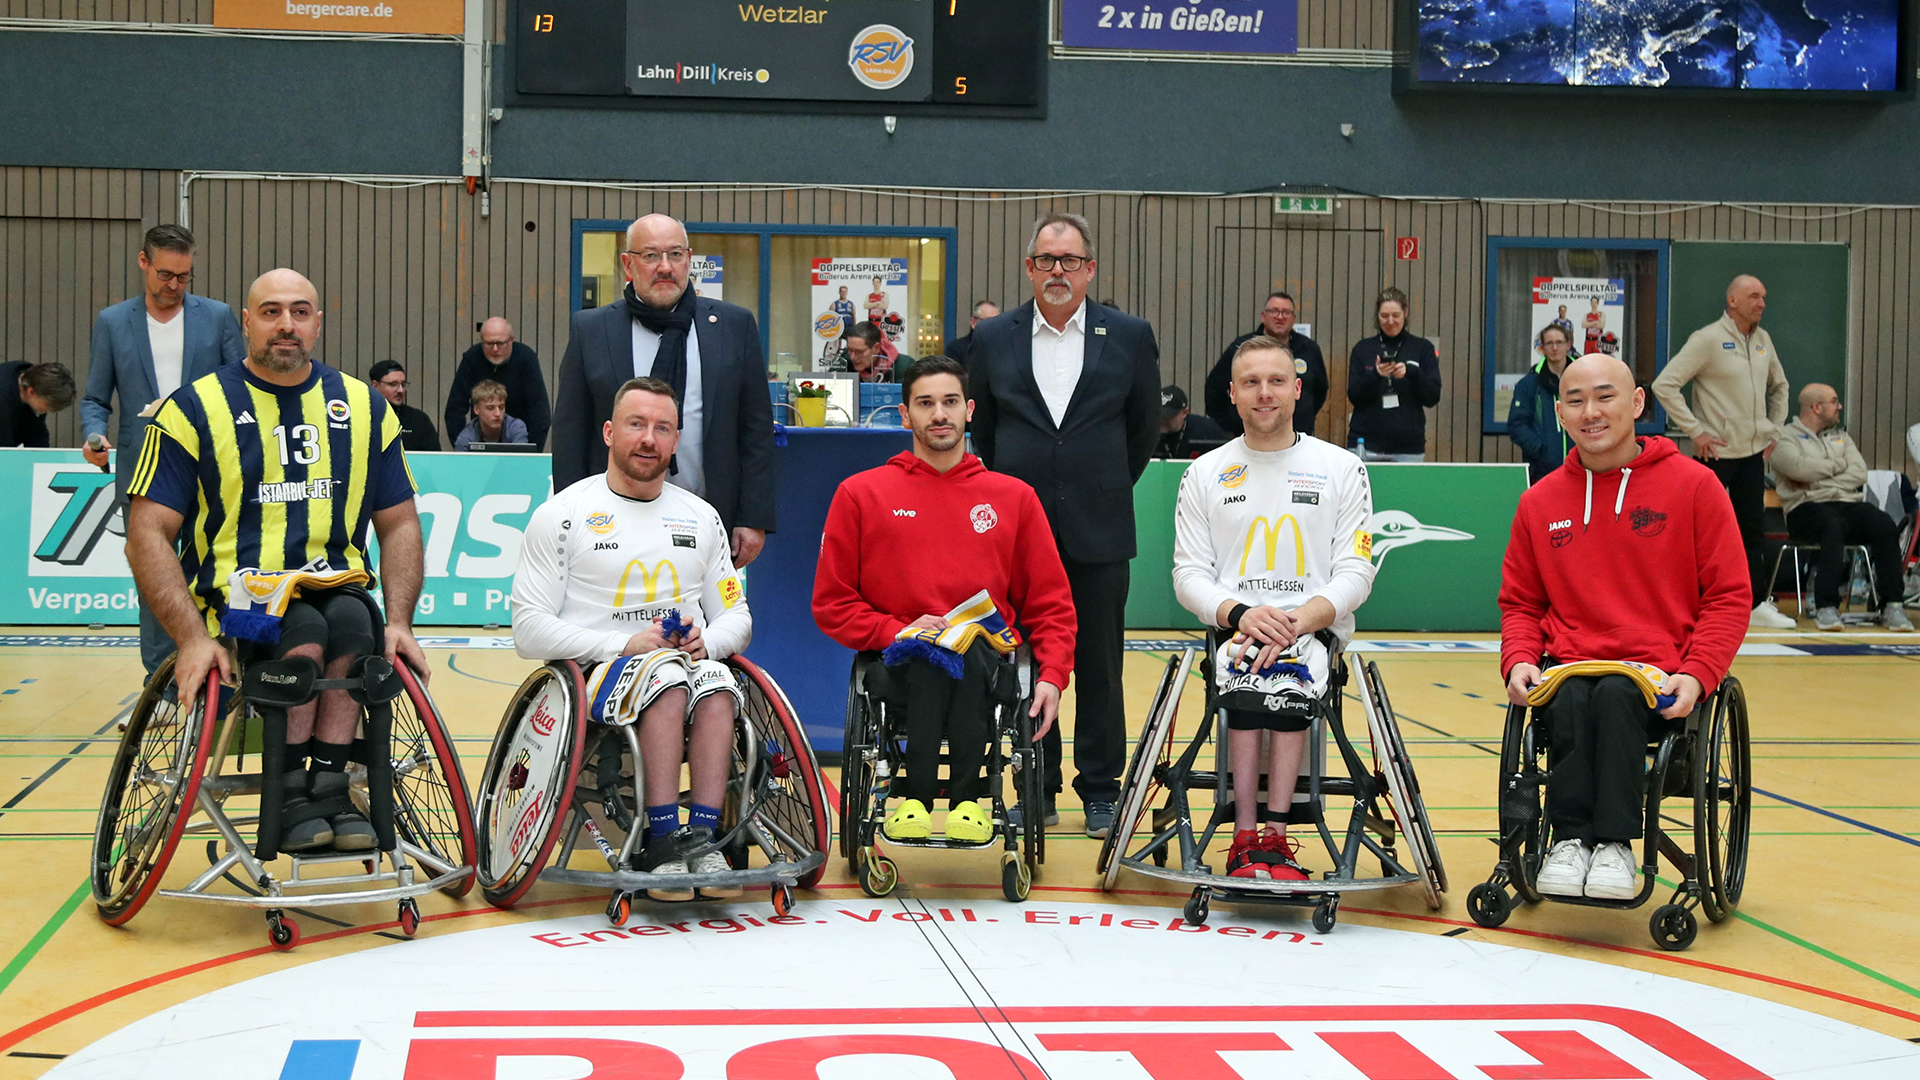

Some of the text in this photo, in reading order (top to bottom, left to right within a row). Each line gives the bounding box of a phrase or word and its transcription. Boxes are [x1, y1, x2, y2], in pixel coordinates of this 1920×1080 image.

[286, 0, 394, 18] bergercare.de
[739, 4, 828, 24] Wetzlar
[534, 14, 553, 32] 13
[1099, 5, 1264, 33] 2 x in Gießen!
[850, 40, 912, 66] RSV
[638, 65, 753, 82] Lahn Dill Kreis
[956, 77, 967, 95] 5
[820, 263, 900, 272] DOPPELSPIELTAG
[1540, 283, 1617, 292] DOPPELSPIELTAG
[815, 317, 842, 332] RSV
[272, 423, 321, 466] 13
[1217, 465, 1248, 484] RSV
[310, 478, 332, 499] JET
[1223, 495, 1246, 505] JAKO
[586, 514, 615, 527] RSV
[892, 508, 917, 518] vive
[1548, 519, 1572, 532] JAKO
[594, 542, 619, 551] JAKO
[28, 587, 140, 614] Verpack
[1263, 694, 1289, 711] RGK
[530, 695, 556, 737] Leica
[510, 790, 543, 858] Leica
[530, 908, 1323, 948] Energie. Voll. Erleben.
